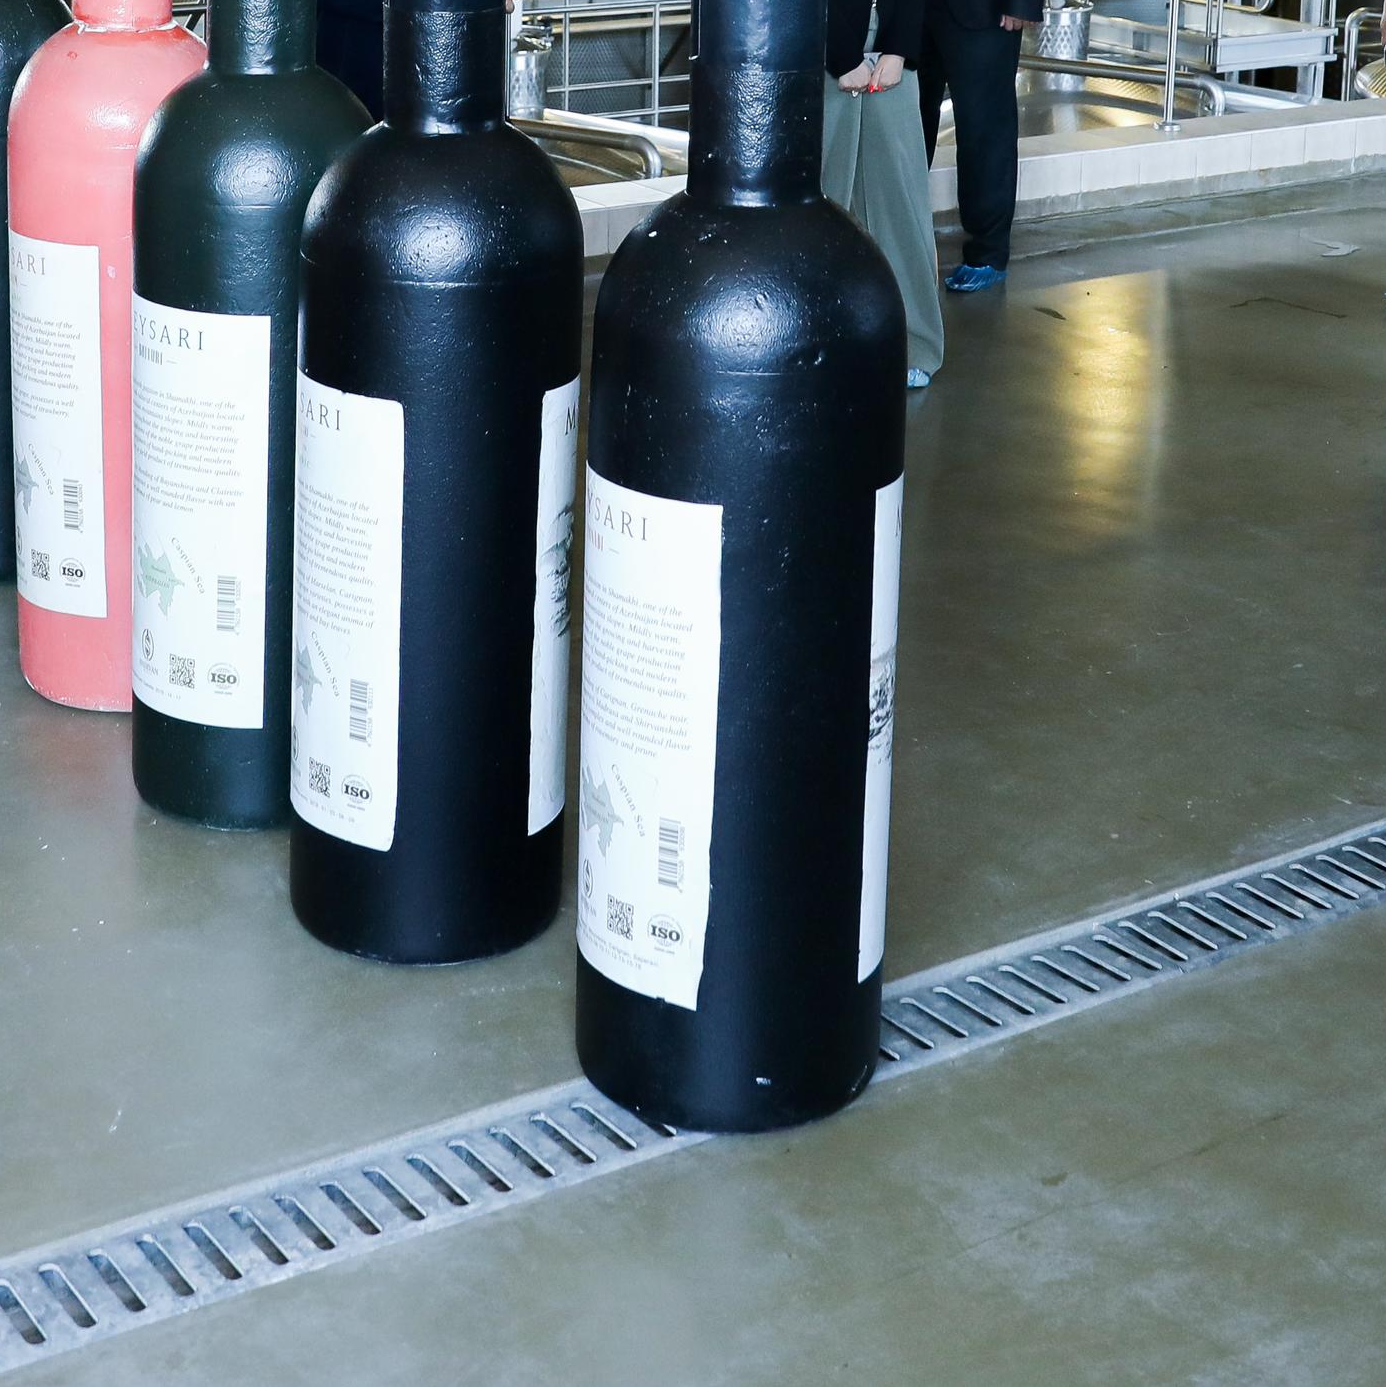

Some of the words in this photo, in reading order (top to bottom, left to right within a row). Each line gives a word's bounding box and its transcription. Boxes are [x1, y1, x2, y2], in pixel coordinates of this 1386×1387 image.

[10, 246, 45, 275] SARI
[134, 311, 203, 350] EYSARI
[300, 392, 340, 430] SARI
[564, 401, 576, 435] M
[586, 490, 648, 542] YSARI
[61, 567, 83, 578] ISO
[171, 537, 195, 574] Caspian
[195, 575, 205, 593] Sea
[210, 673, 237, 685] ISO
[310, 630, 331, 672] Caspian
[331, 677, 340, 696] Sea
[343, 784, 369, 800] ISO
[611, 763, 636, 811] Caspian
[635, 814, 645, 837] Sea
[649, 924, 681, 942] ISO
